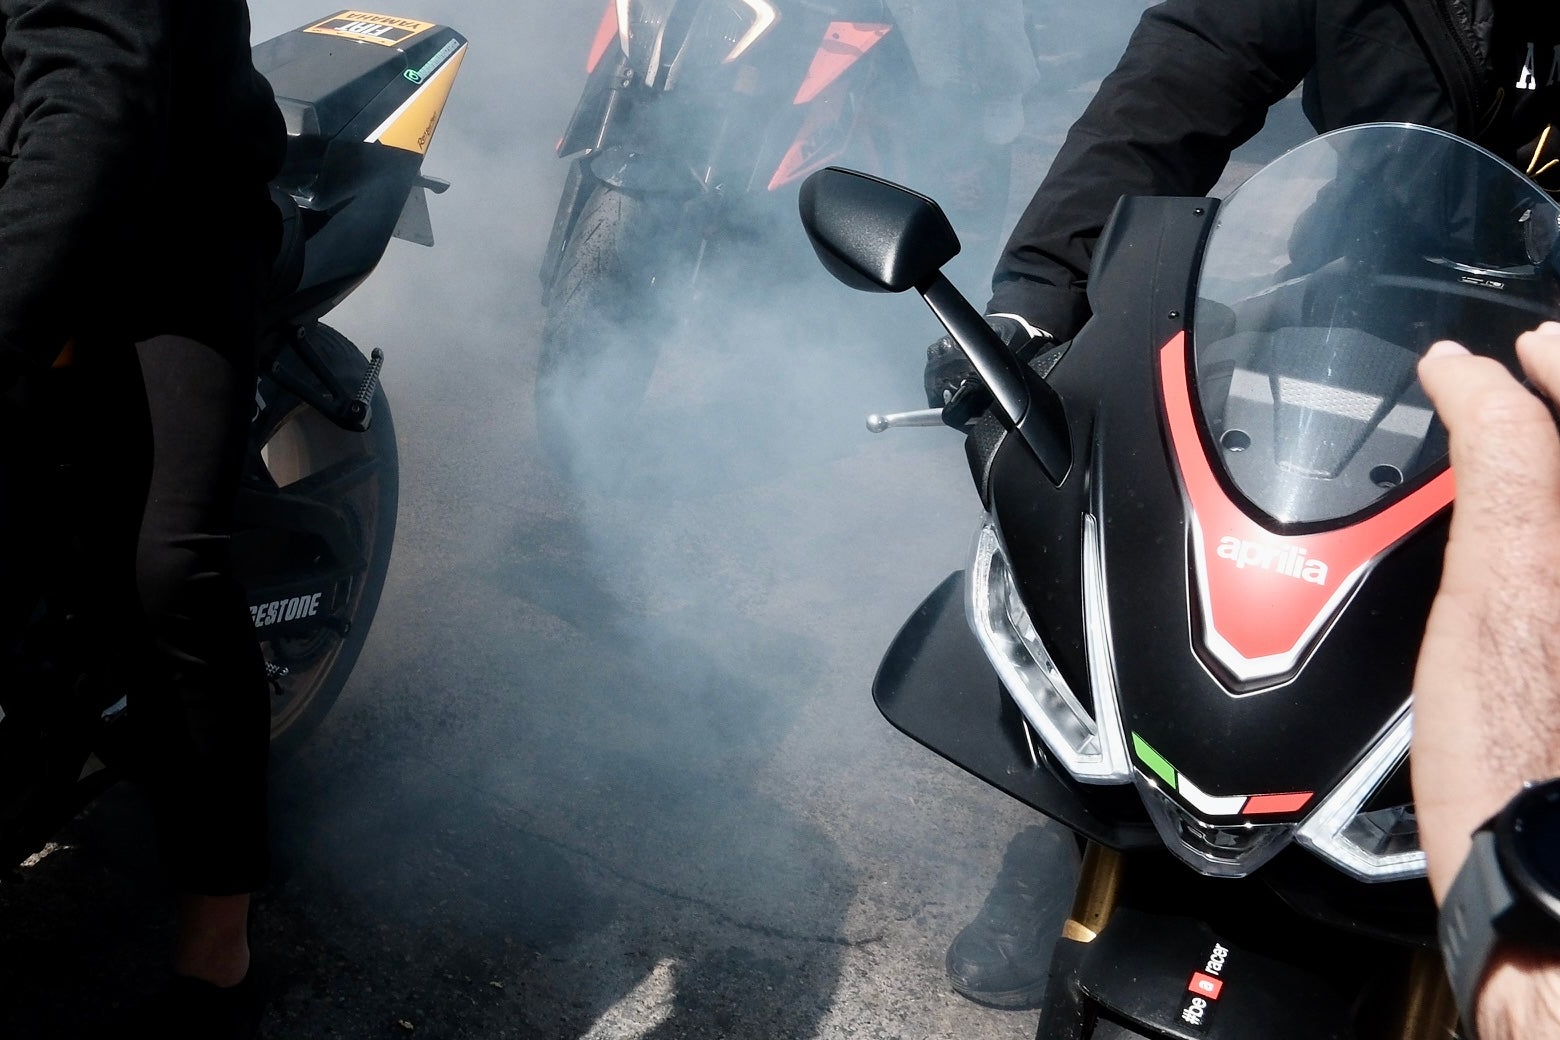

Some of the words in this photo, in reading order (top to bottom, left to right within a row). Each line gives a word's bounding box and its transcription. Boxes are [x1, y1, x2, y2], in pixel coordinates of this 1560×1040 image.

[334, 21, 394, 37] FIAT
[346, 13, 421, 29] YAMAHA
[1217, 536, 1329, 586] aprilia
[1204, 943, 1229, 975] racer
[1198, 980, 1215, 992] a
[1181, 997, 1207, 1025] #be
